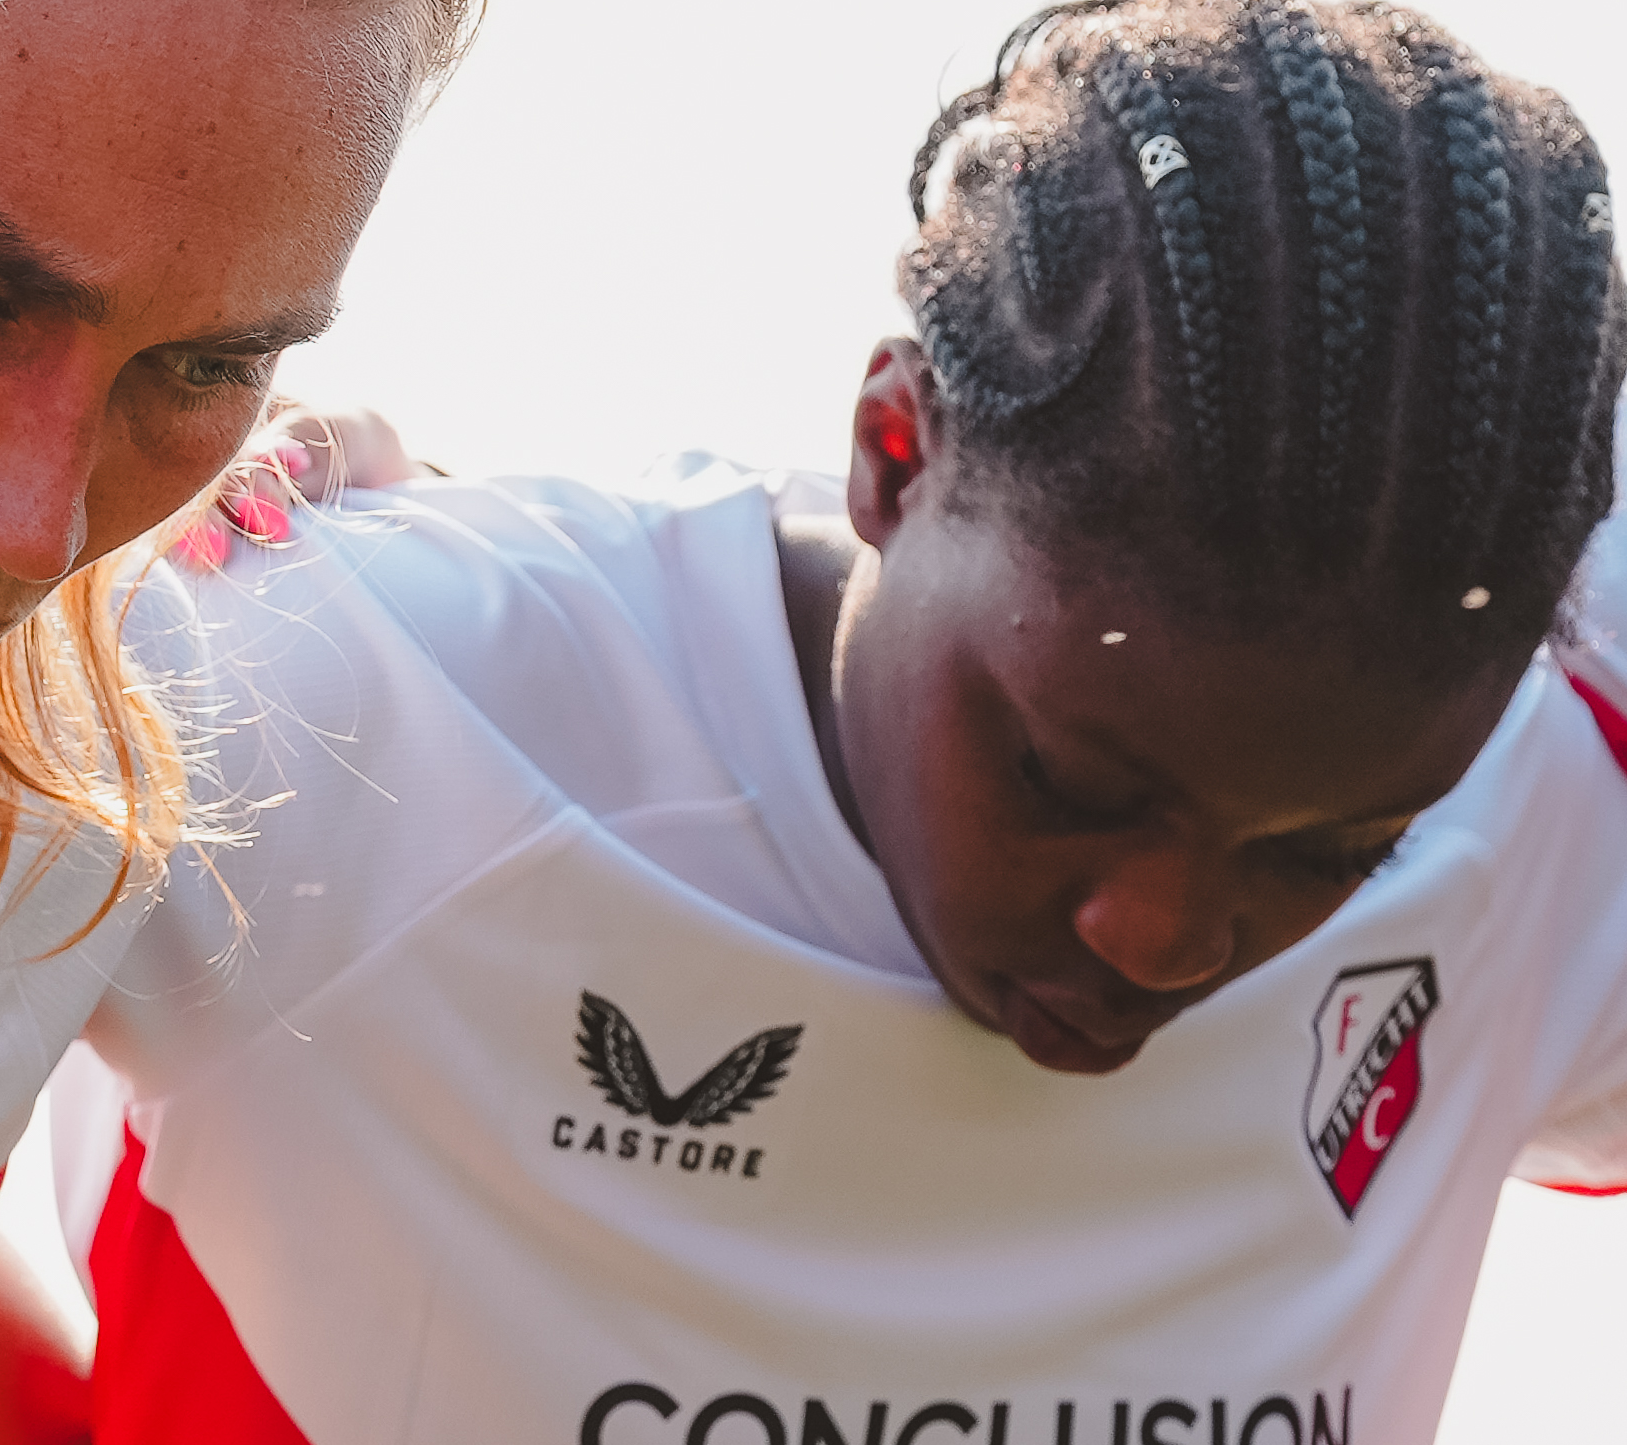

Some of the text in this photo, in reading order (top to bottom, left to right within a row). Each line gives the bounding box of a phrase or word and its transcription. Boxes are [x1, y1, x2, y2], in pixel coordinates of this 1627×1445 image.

[1335, 993, 1362, 1056] F
[553, 1116, 765, 1180] CASTORE
[1363, 1086, 1396, 1151] C
